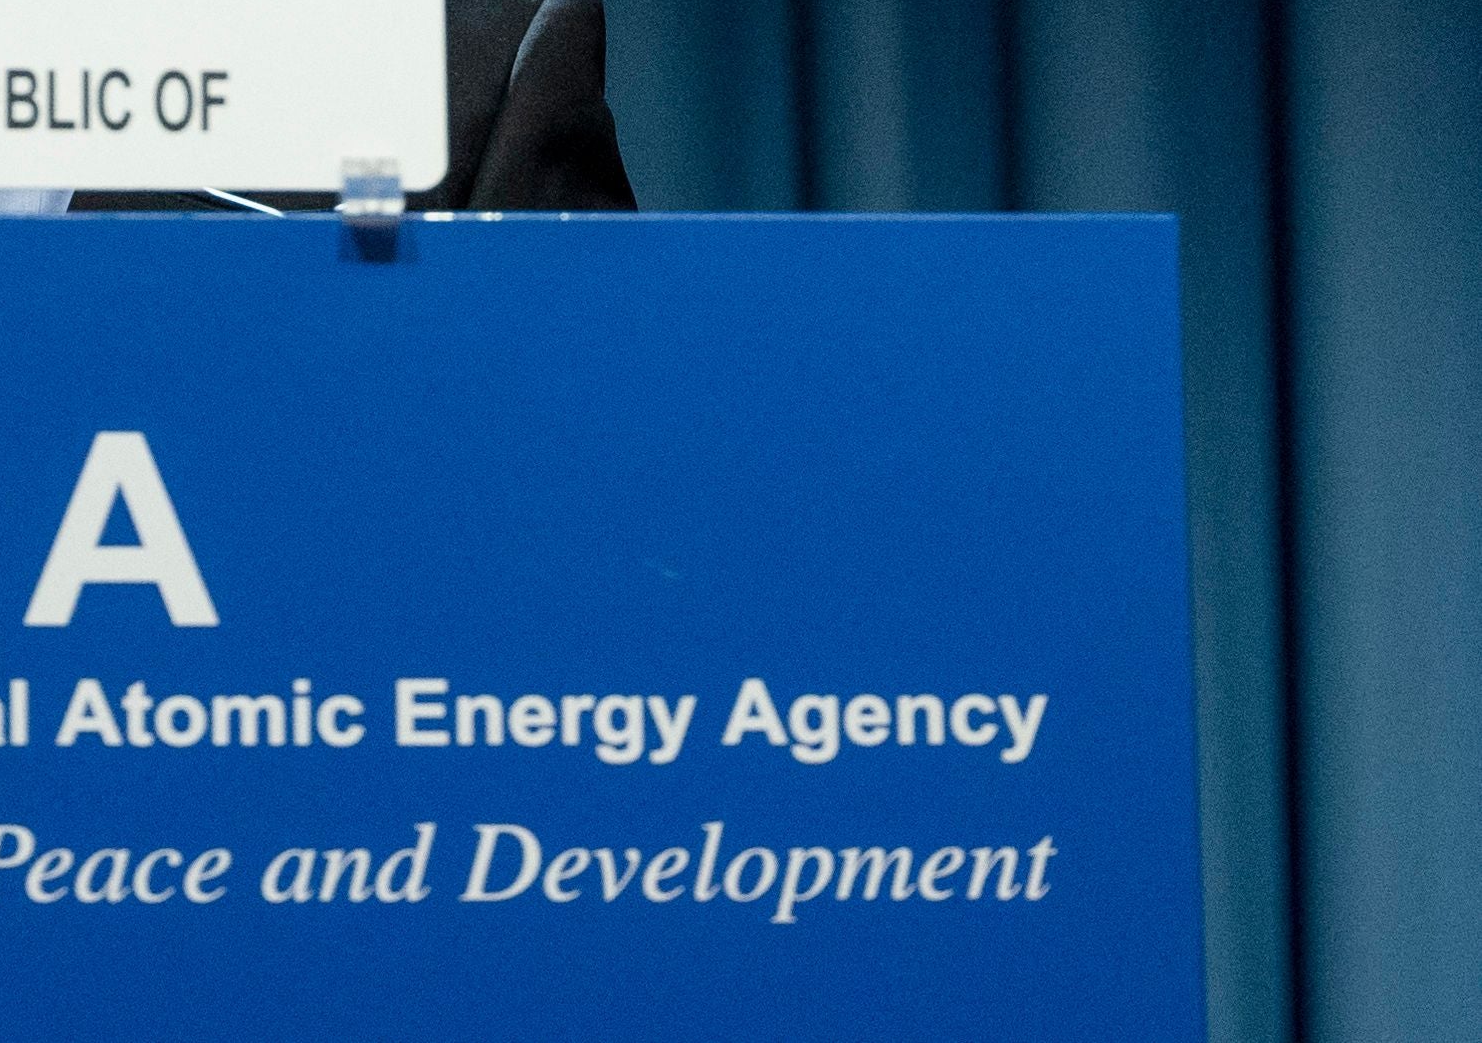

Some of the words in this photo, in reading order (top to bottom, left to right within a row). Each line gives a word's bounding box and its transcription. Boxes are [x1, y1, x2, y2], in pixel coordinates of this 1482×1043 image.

[153, 69, 230, 134] OF
[55, 677, 365, 748] Atomic
[394, 677, 698, 765] Energy
[721, 677, 1048, 765] Agency
[260, 821, 436, 905] and
[461, 821, 1056, 924] Development
